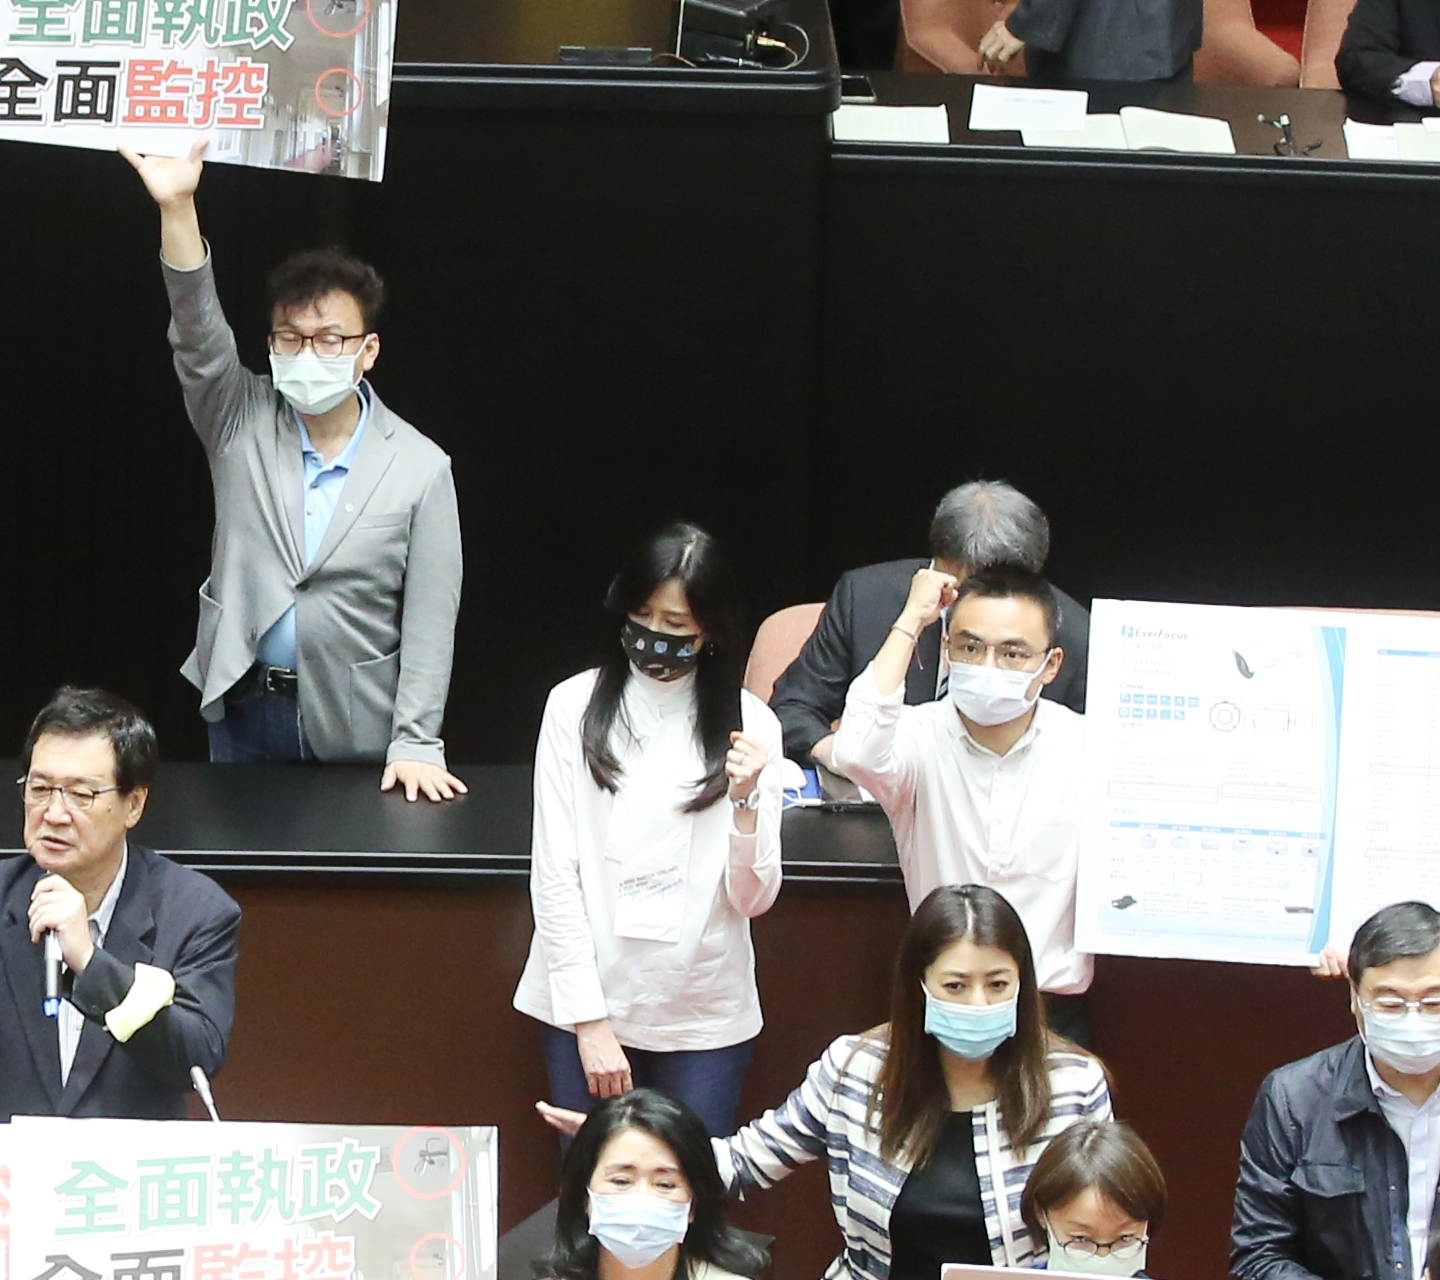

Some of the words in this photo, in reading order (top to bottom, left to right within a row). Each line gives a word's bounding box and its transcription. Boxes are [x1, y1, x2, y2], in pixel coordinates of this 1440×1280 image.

[1135, 628, 1188, 640] EverFocus
[53, 1139, 381, 1240] 全面執政
